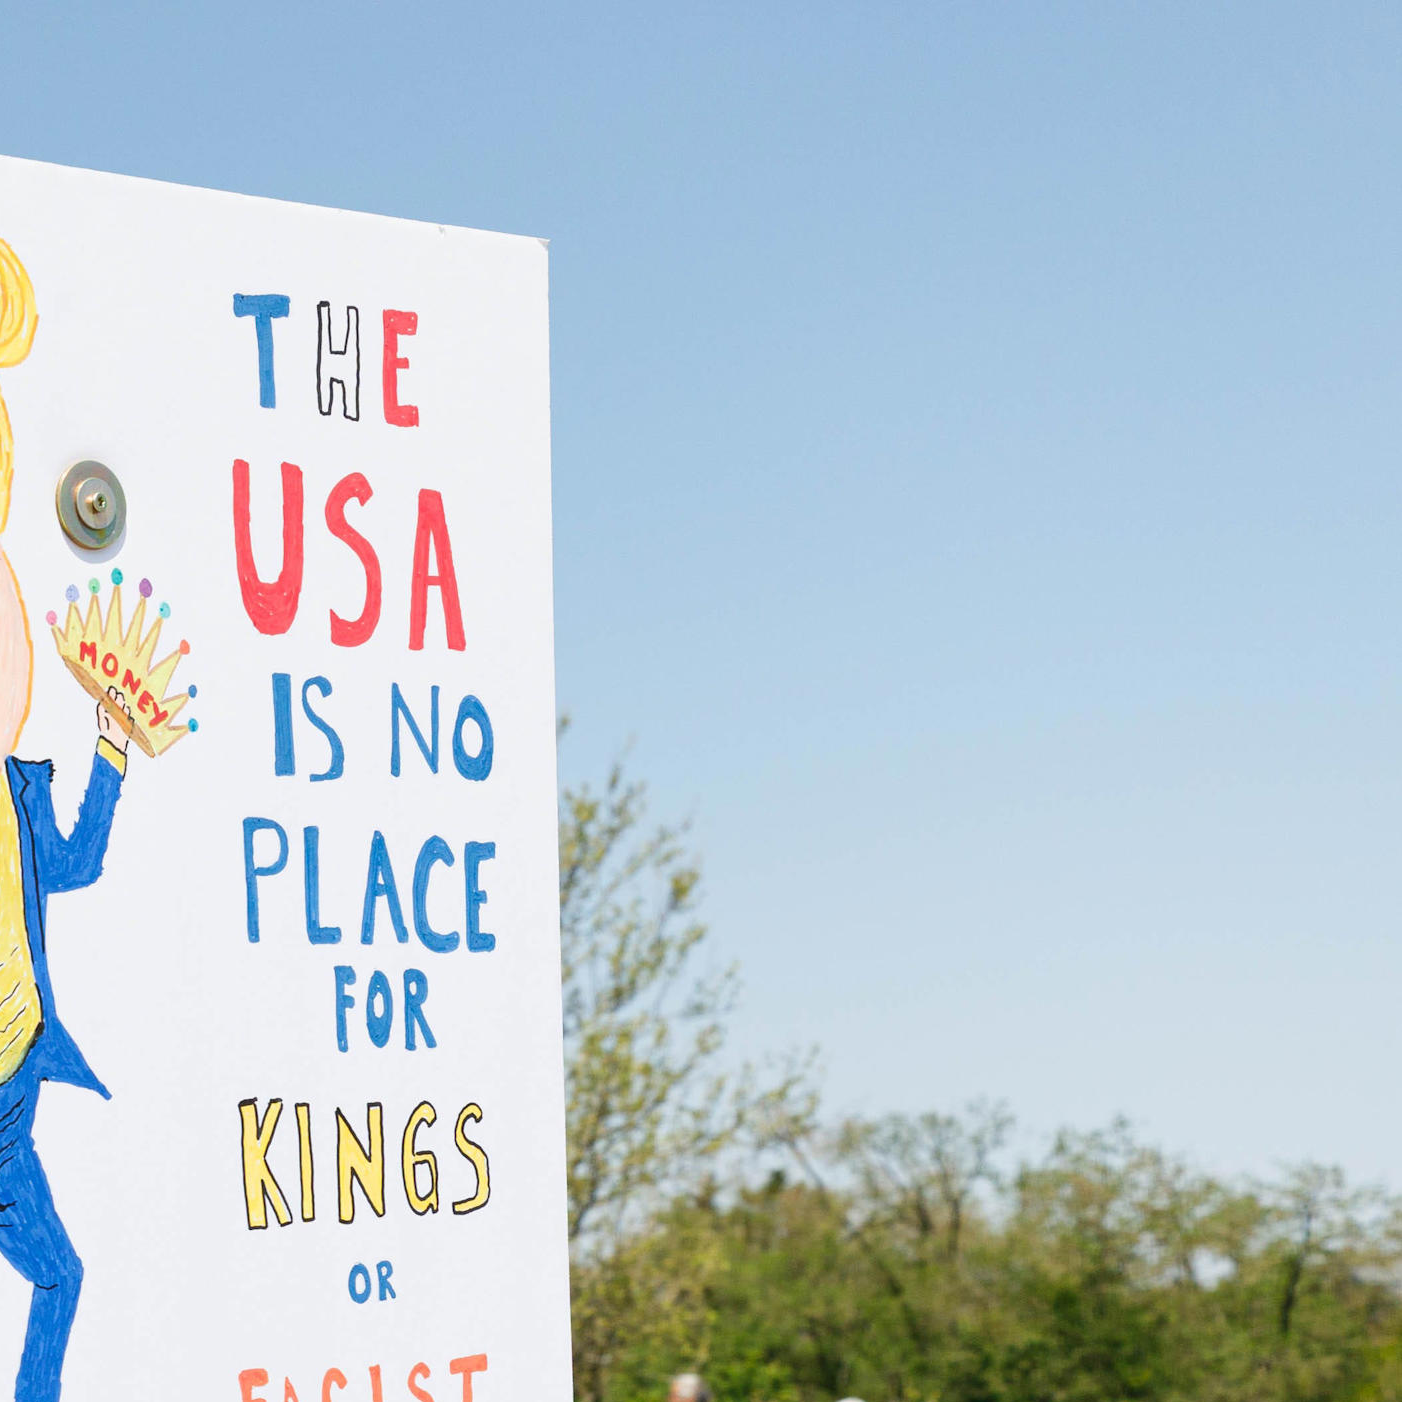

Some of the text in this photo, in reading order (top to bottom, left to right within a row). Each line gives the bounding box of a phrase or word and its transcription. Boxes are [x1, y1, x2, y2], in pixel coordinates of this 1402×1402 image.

[232, 292, 419, 427] THE
[232, 458, 467, 652] USA
[79, 641, 169, 728] MONEY
[271, 672, 494, 782] IS NO
[242, 817, 496, 953] PLACE
[333, 965, 437, 1053] FOR
[238, 1097, 490, 1230] KINGS
[347, 1260, 397, 1304] OR
